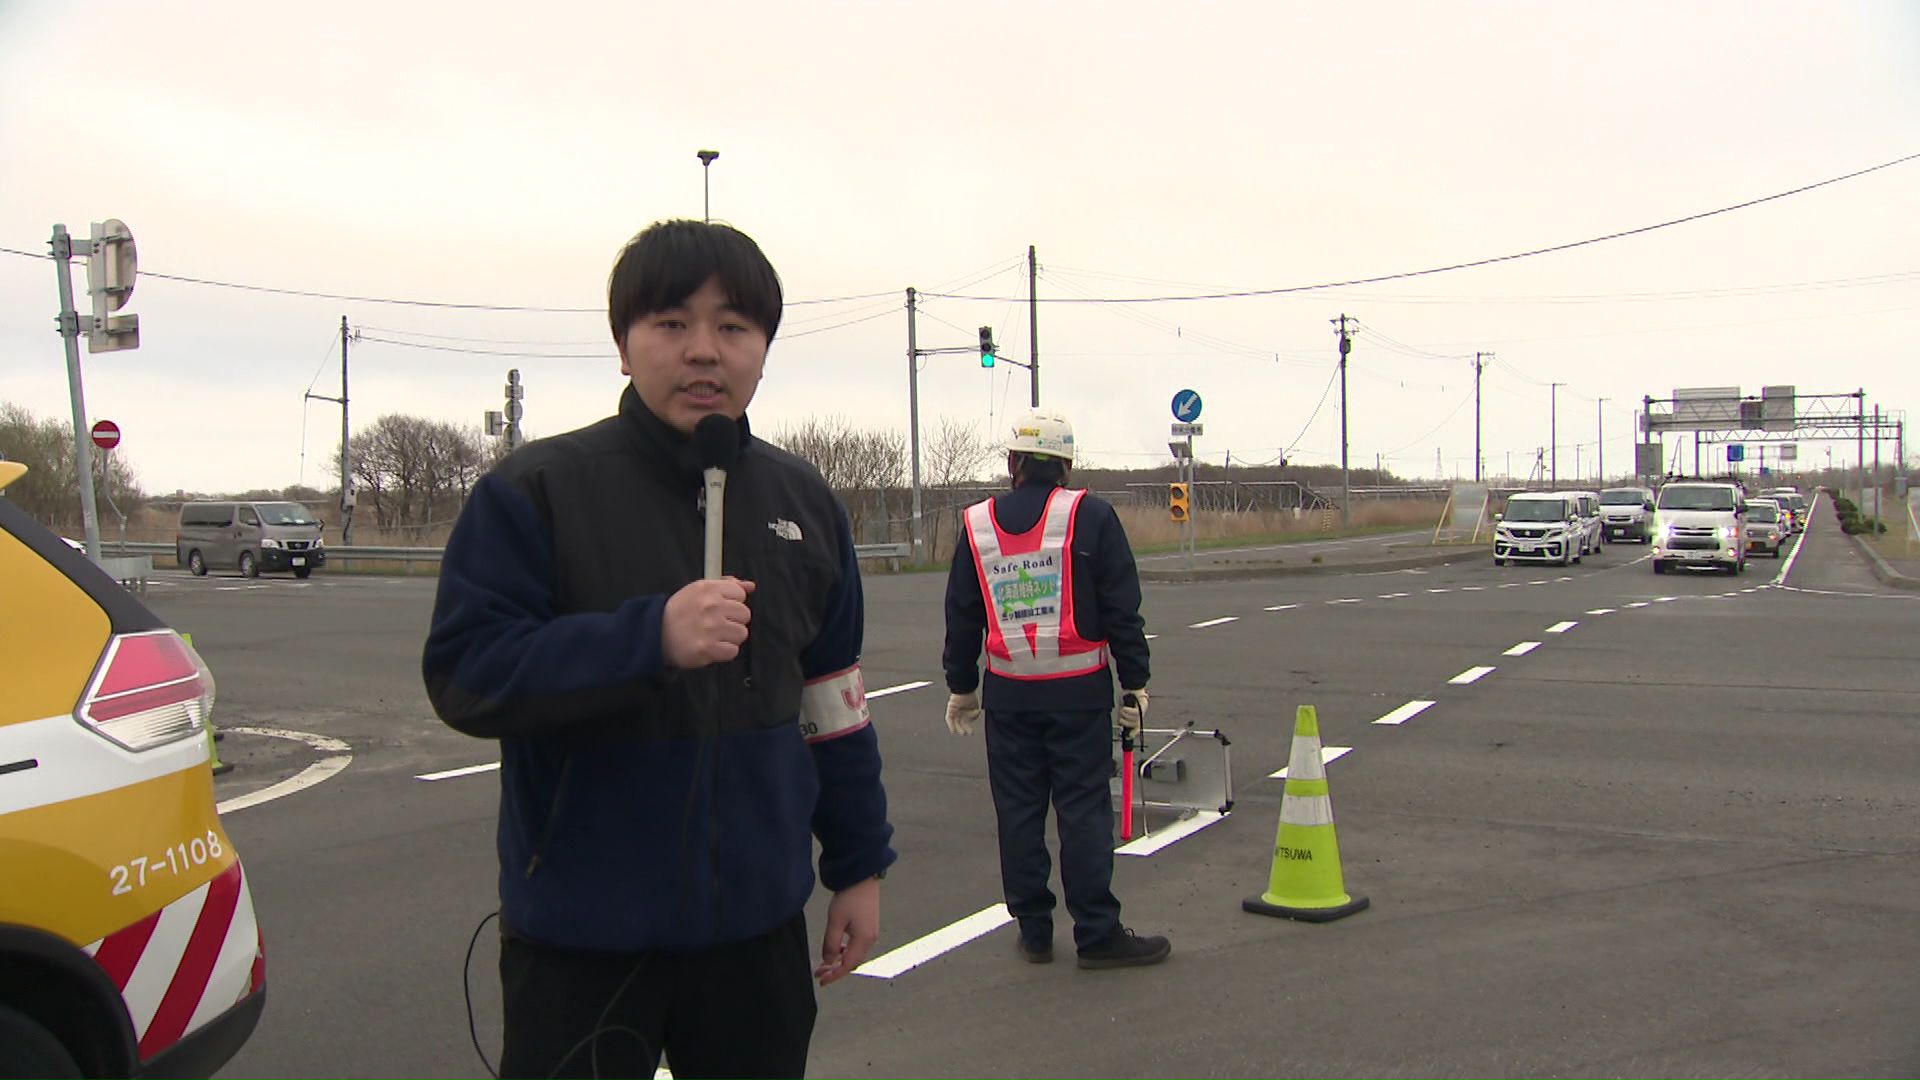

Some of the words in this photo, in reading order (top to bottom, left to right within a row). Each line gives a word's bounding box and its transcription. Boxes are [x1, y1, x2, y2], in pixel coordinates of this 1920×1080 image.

[993, 562, 1018, 575] Safe
[1023, 555, 1053, 570] Road
[109, 831, 223, 896] 27-1108
